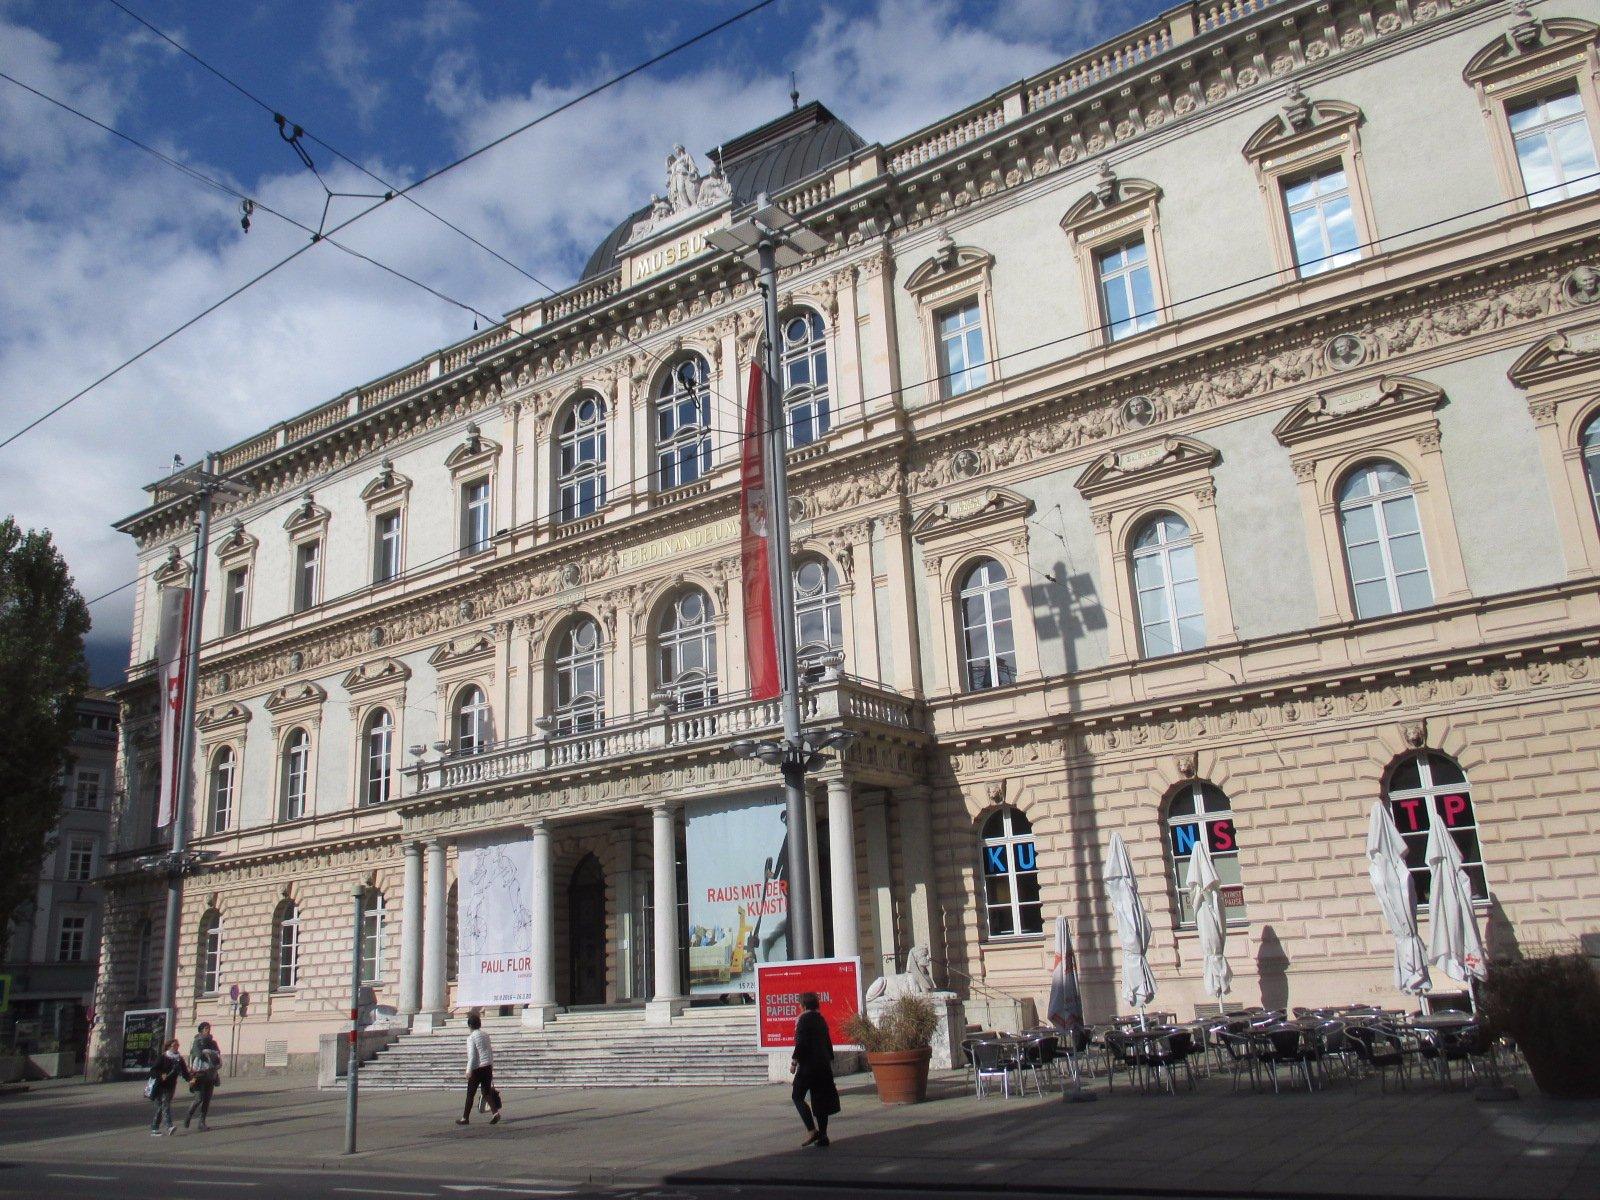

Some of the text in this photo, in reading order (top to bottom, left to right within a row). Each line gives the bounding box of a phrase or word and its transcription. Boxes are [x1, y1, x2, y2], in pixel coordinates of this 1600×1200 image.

[620, 520, 738, 568] FERDINANDEUM
[707, 880, 789, 902] RAUS MIT DER
[481, 957, 532, 974] PAUL FLOR
[766, 1005, 797, 1017] PAPIER
